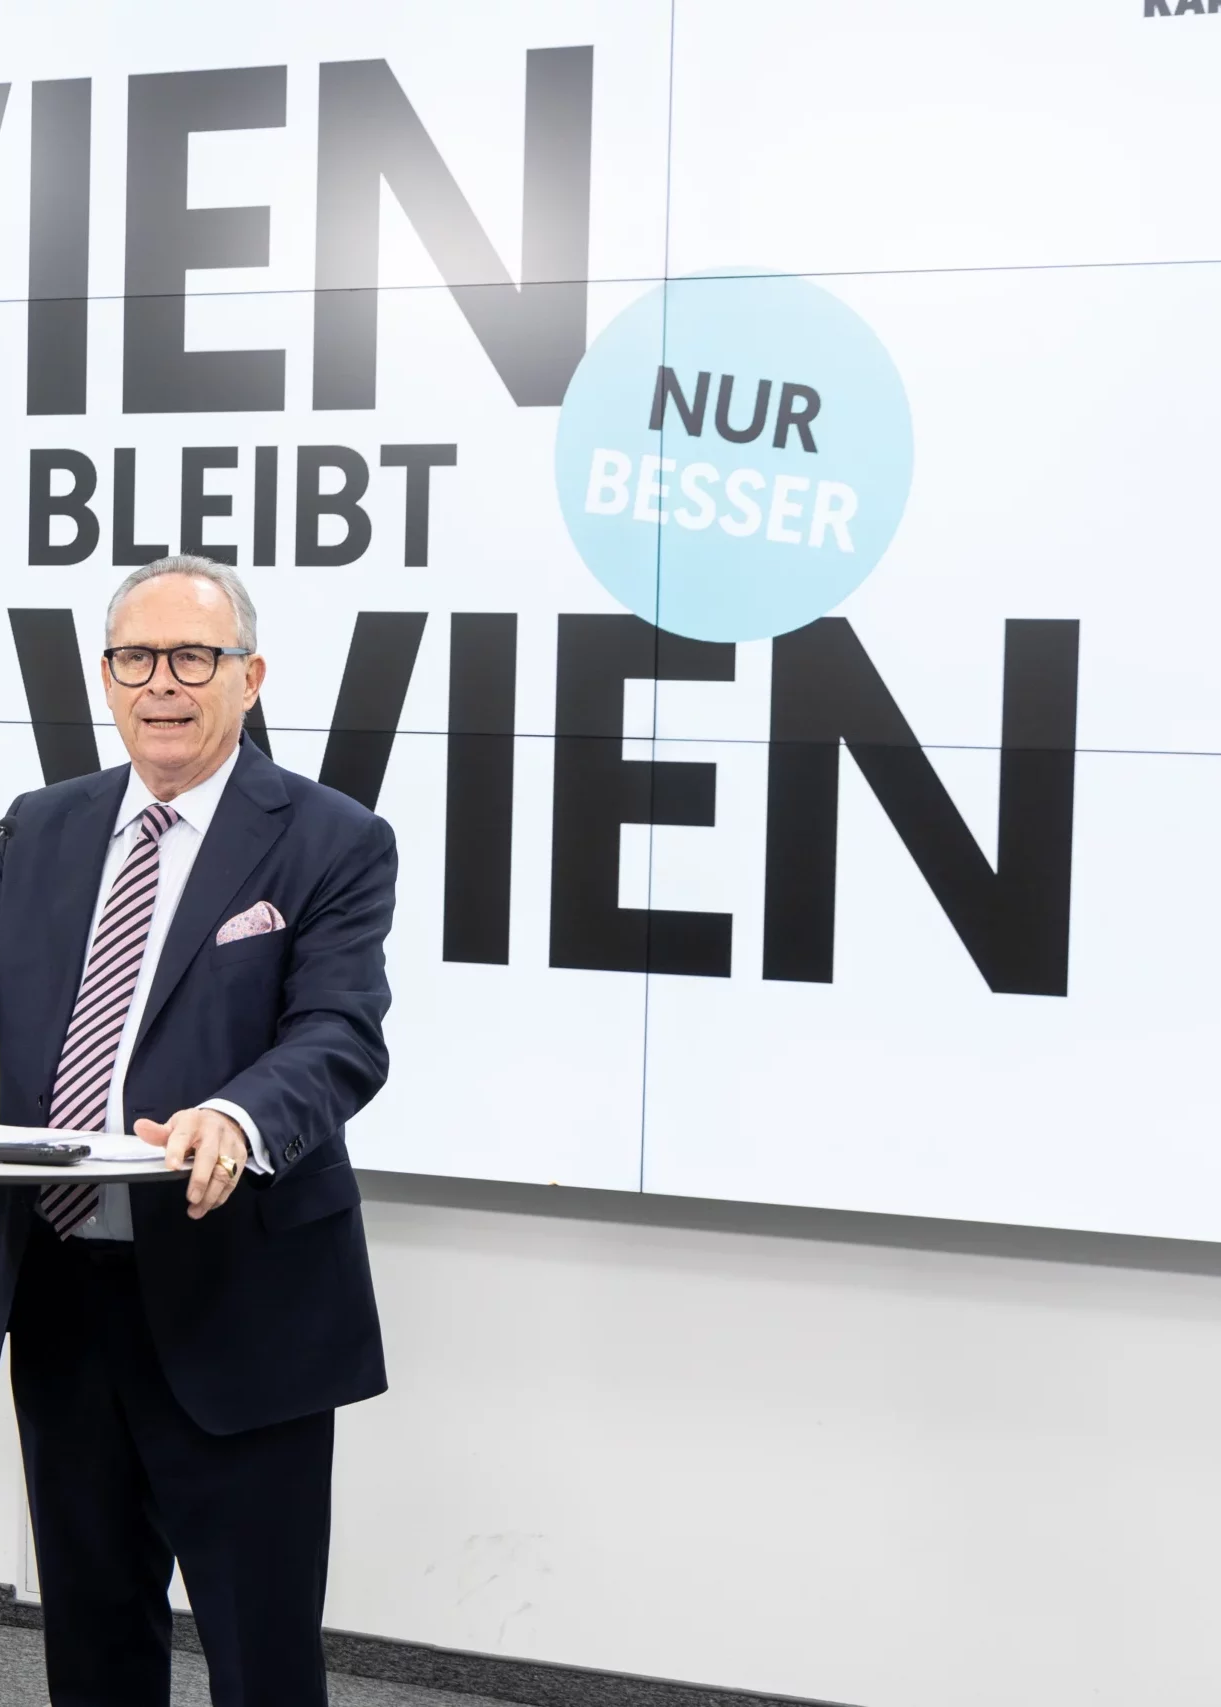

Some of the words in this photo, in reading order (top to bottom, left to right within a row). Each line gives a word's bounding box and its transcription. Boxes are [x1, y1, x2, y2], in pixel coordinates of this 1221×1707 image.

[648, 365, 821, 454] NUR
[28, 443, 458, 568] BLEIBT
[584, 447, 859, 553] BESSER
